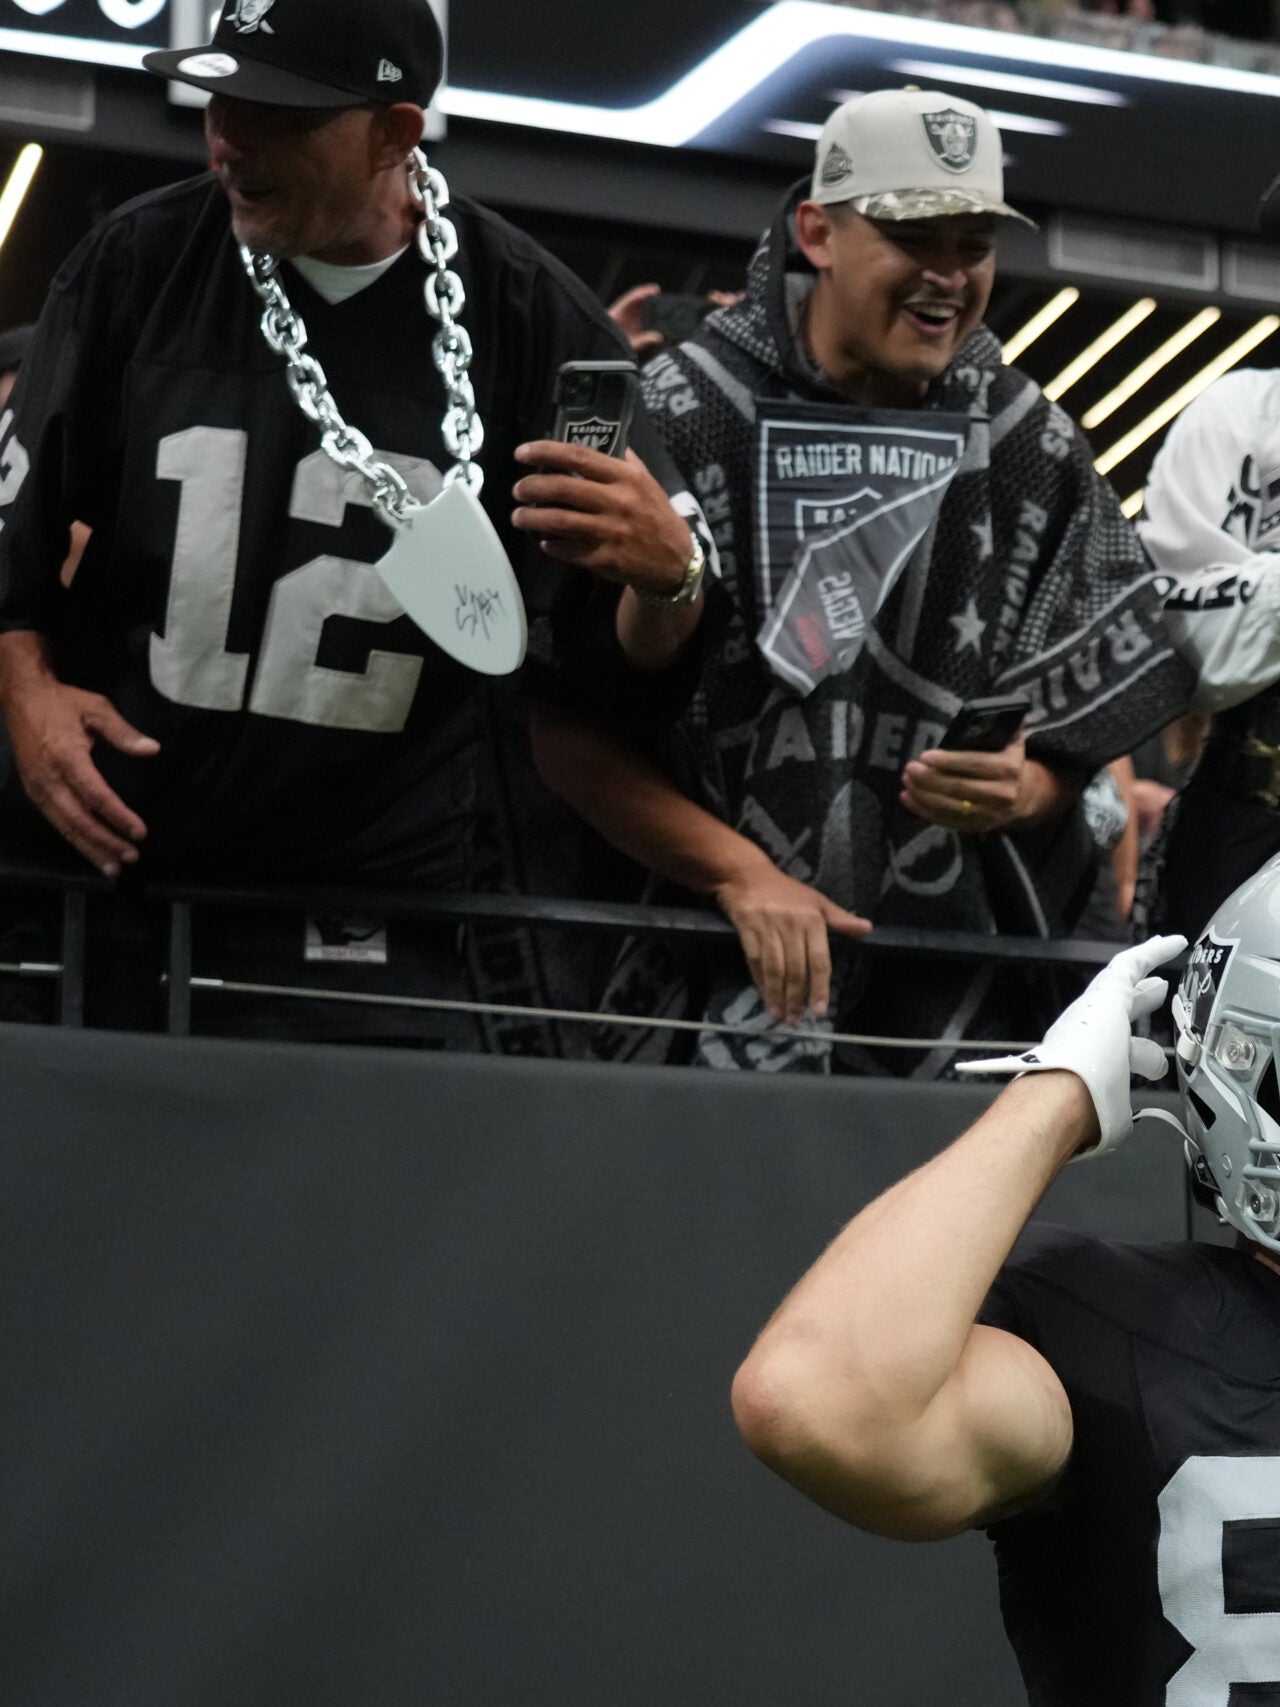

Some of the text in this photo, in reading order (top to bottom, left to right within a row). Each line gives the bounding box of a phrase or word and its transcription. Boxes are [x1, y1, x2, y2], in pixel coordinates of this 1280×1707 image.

[571, 425, 613, 434] RAIDERS
[776, 443, 862, 480] RAIDER
[149, 425, 444, 733] 12
